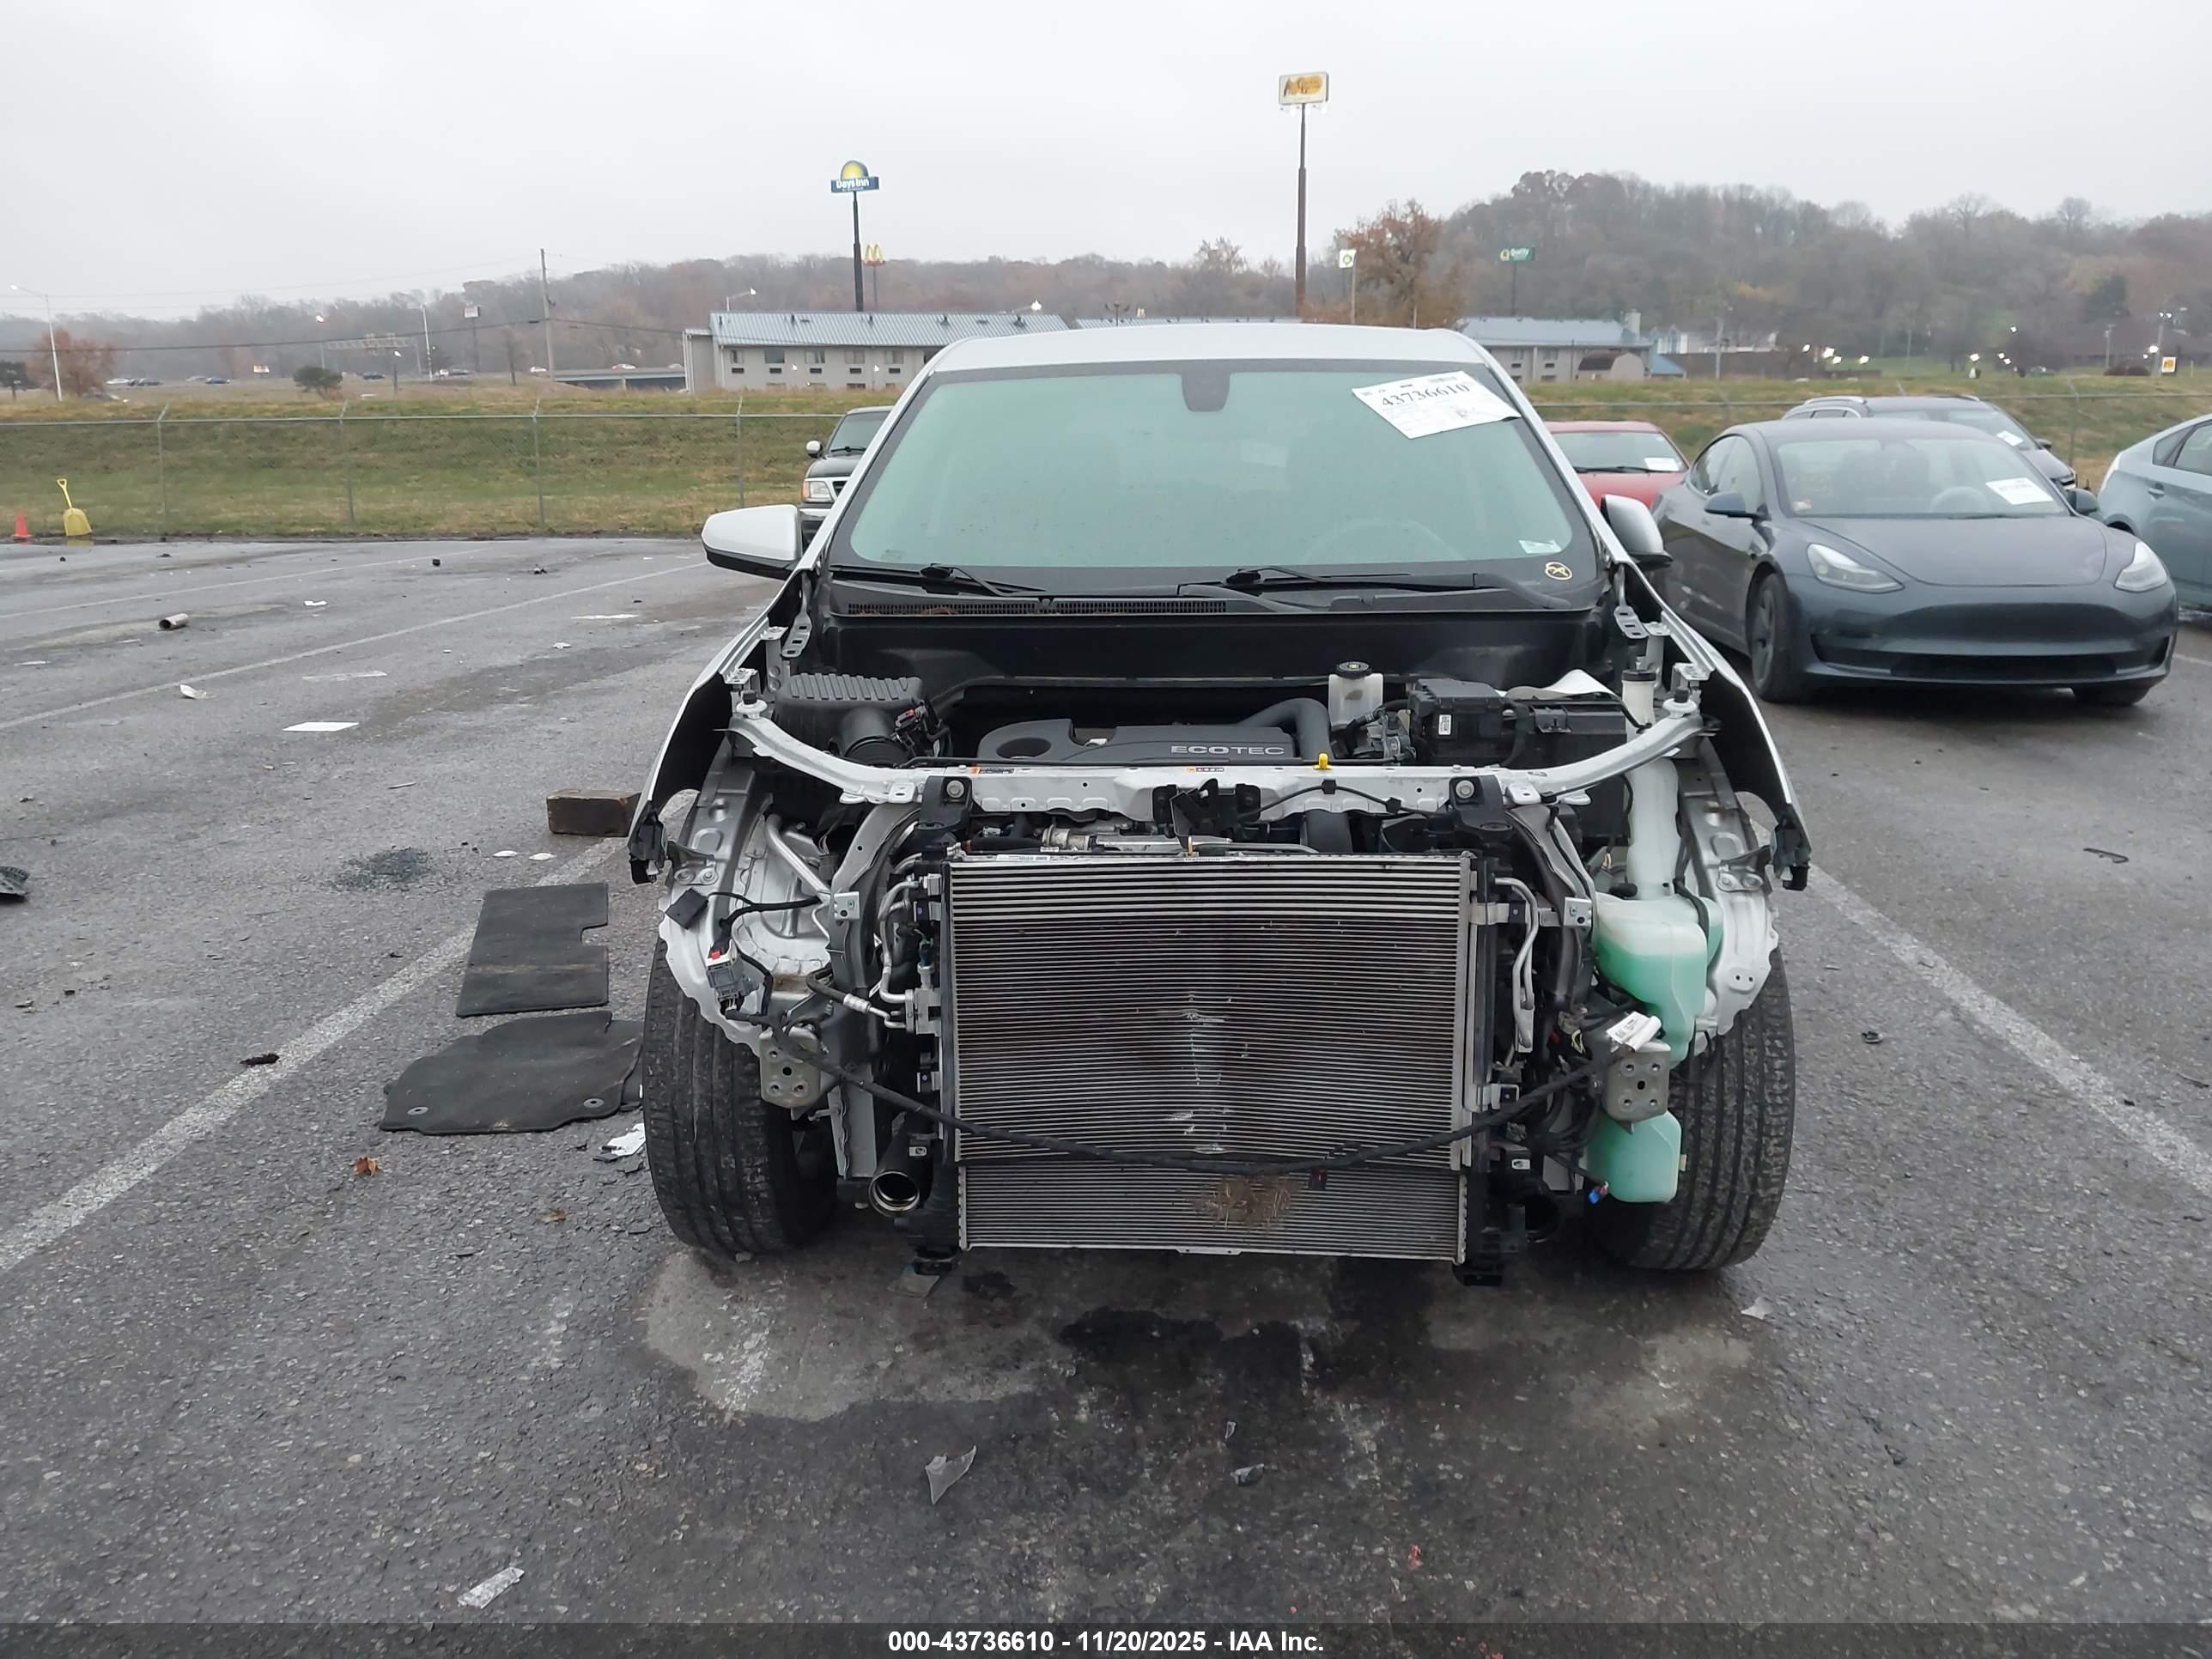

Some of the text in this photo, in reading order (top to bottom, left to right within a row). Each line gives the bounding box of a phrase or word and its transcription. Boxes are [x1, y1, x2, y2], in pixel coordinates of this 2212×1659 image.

[836, 179, 855, 189] Days
[1382, 383, 1470, 406] 43736610
[1170, 745, 1285, 755] ECOTEC
